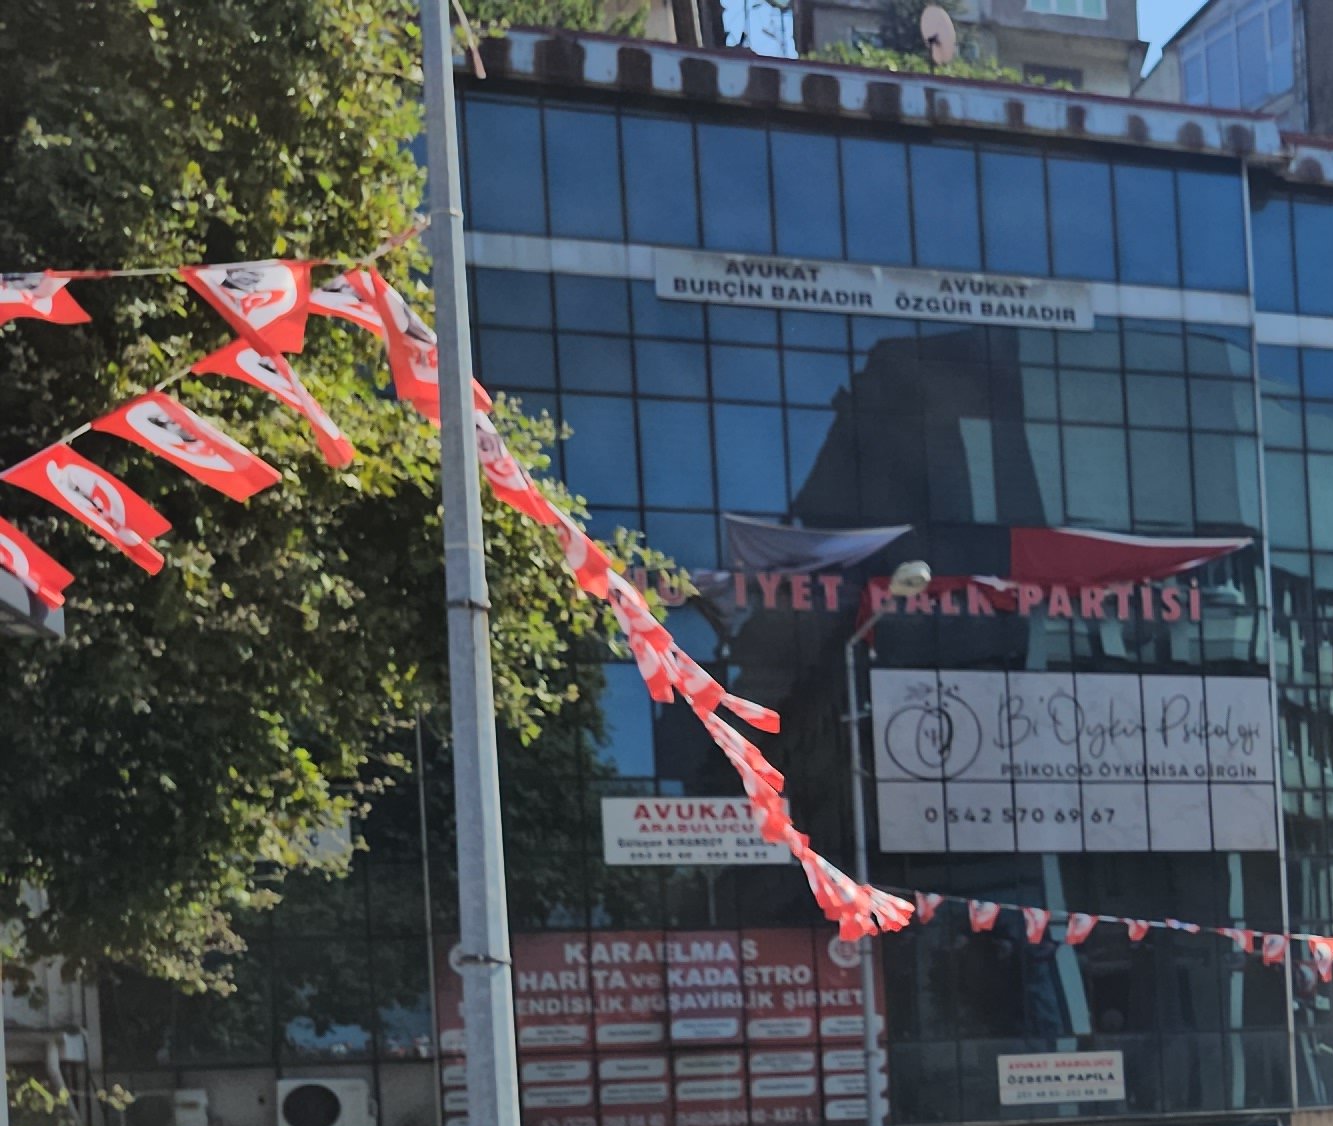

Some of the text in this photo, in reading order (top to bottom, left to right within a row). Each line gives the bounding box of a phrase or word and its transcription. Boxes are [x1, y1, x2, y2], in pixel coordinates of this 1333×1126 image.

[725, 260, 821, 283] AVUKAT
[673, 276, 873, 308] BURÇİN BAHADIR
[938, 278, 1028, 300] AVUKAT
[895, 294, 1077, 323] ÖZGÜR BAHADIR
[1018, 577, 1201, 622] PARTİSİ
[1000, 761, 1093, 778] PSİKOLOG
[633, 803, 756, 820] AVUKAT
[925, 808, 938, 824] 0
[947, 808, 993, 824] 542
[1002, 808, 1045, 825] 570
[1091, 808, 1116, 825] 67
[564, 938, 758, 964] KARAELMAS
[518, 965, 812, 992] HARİTA ve KADASTRO
[782, 986, 866, 1011] ŞİRKET
[1067, 1071, 1116, 1082] PAPİLA
